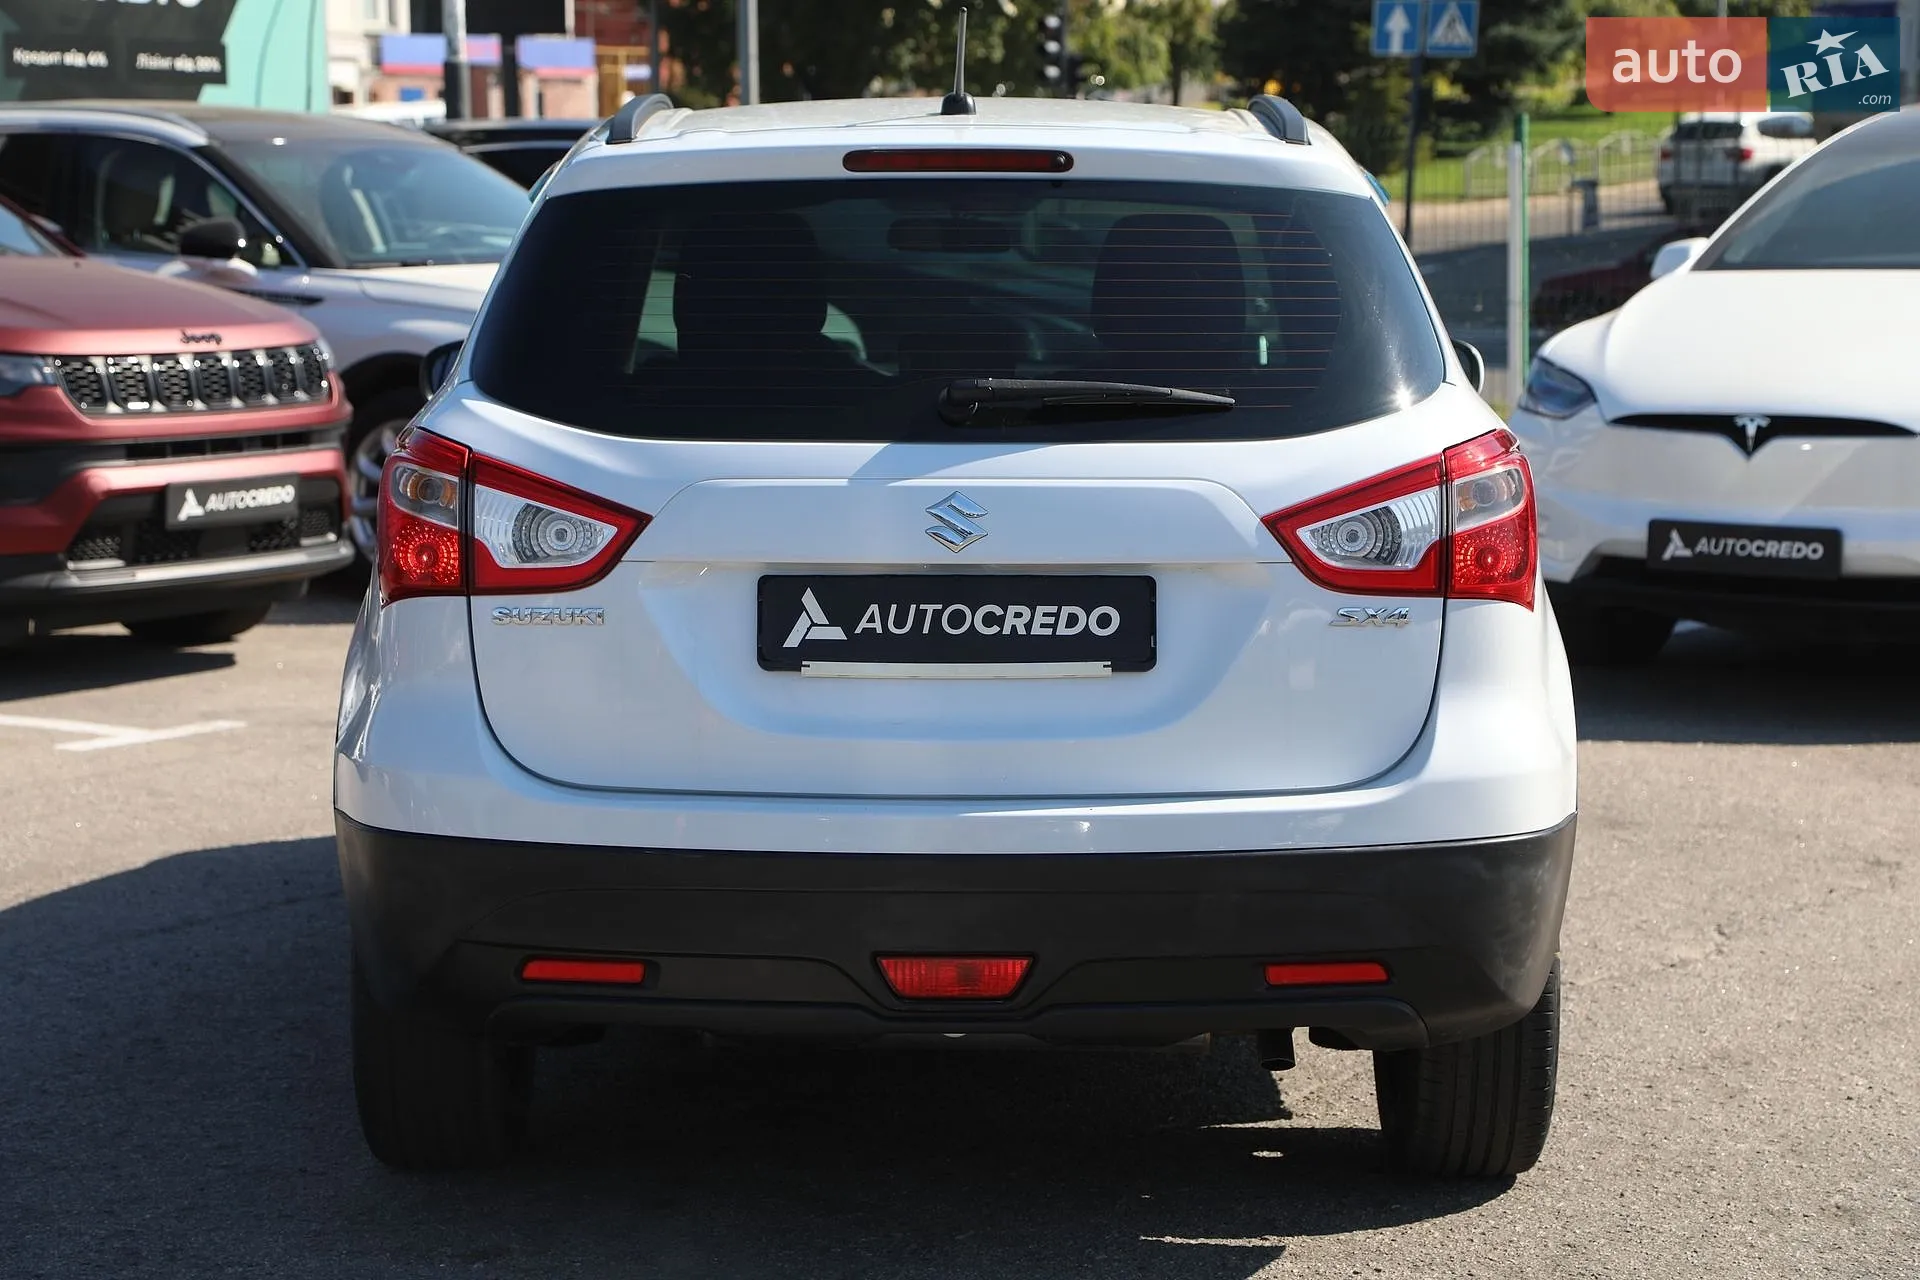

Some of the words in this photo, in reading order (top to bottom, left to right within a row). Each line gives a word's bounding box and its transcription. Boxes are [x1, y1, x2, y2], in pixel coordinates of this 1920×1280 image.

[205, 484, 296, 512] AUTOCREDO
[1694, 536, 1825, 561] AUTOCREDO
[492, 607, 605, 626] SUZUKI
[854, 603, 1121, 637] AUTOCREDO
[1328, 607, 1410, 628] SX4
